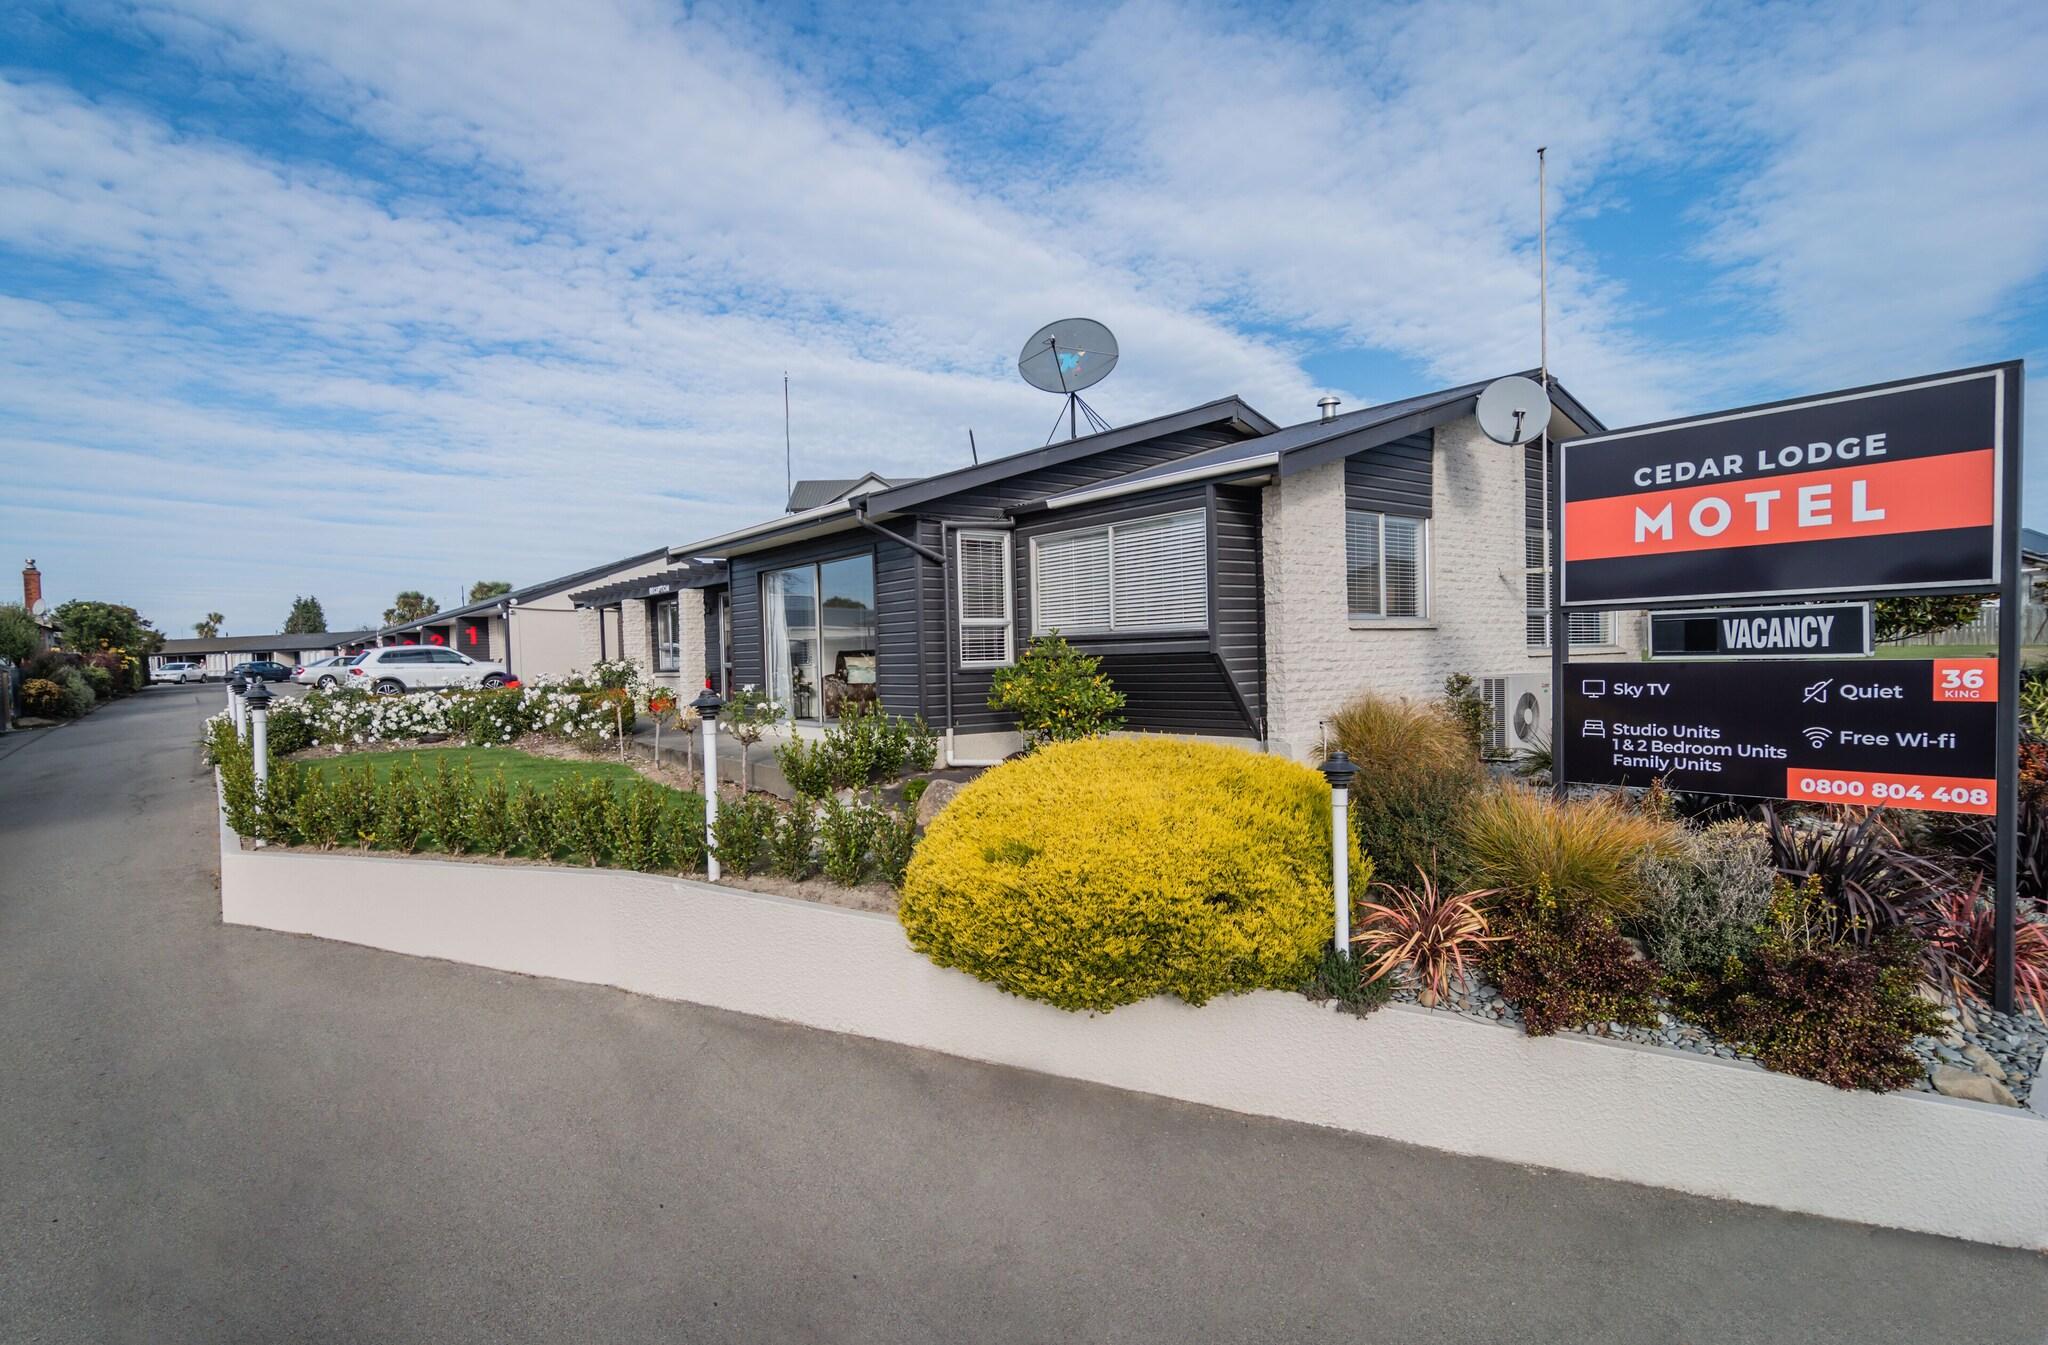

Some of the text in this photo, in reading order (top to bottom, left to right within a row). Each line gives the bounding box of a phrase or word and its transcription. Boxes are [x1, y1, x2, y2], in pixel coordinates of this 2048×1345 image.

[1633, 433, 1888, 487] CEDAR LODGE
[1634, 479, 1886, 544] MOTEL
[465, 626, 478, 646] 1
[1722, 615, 1835, 649] VACANCY
[1941, 669, 1984, 689] 36
[1613, 682, 1670, 698] Sky TV
[1839, 683, 1904, 700] Quiet
[1944, 689, 1980, 698] KING
[1612, 722, 1721, 739] Studio Units
[1840, 730, 1956, 749] Free Wi-fi
[1612, 738, 1787, 759] 1 & 2 Bedroom Units
[1613, 754, 1722, 772] Family Units
[1800, 777, 1989, 805] 0800 804 408
